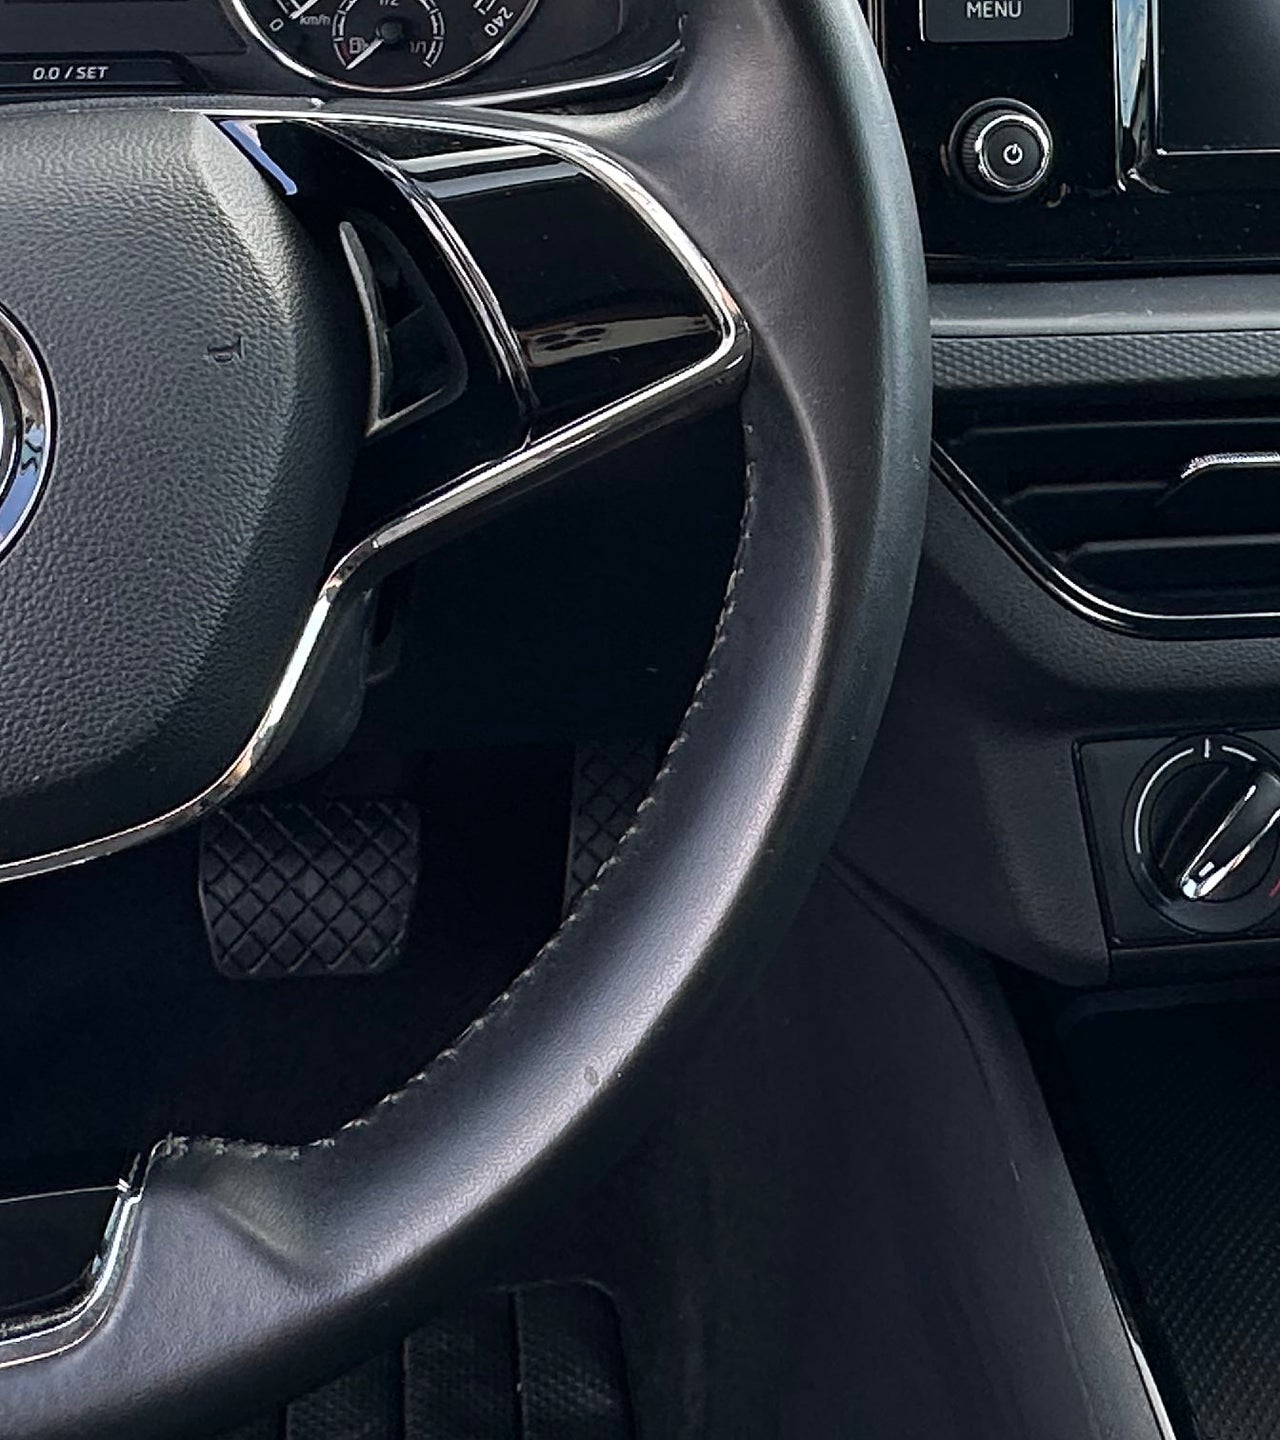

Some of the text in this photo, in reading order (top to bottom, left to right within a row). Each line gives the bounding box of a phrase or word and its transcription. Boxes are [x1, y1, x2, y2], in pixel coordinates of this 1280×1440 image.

[966, 0, 1022, 18] MENU
[269, 17, 284, 33] 0
[299, 14, 331, 25] km/h
[484, 6, 513, 37] 240
[408, 40, 427, 53] 1/1
[75, 66, 109, 80] SET
